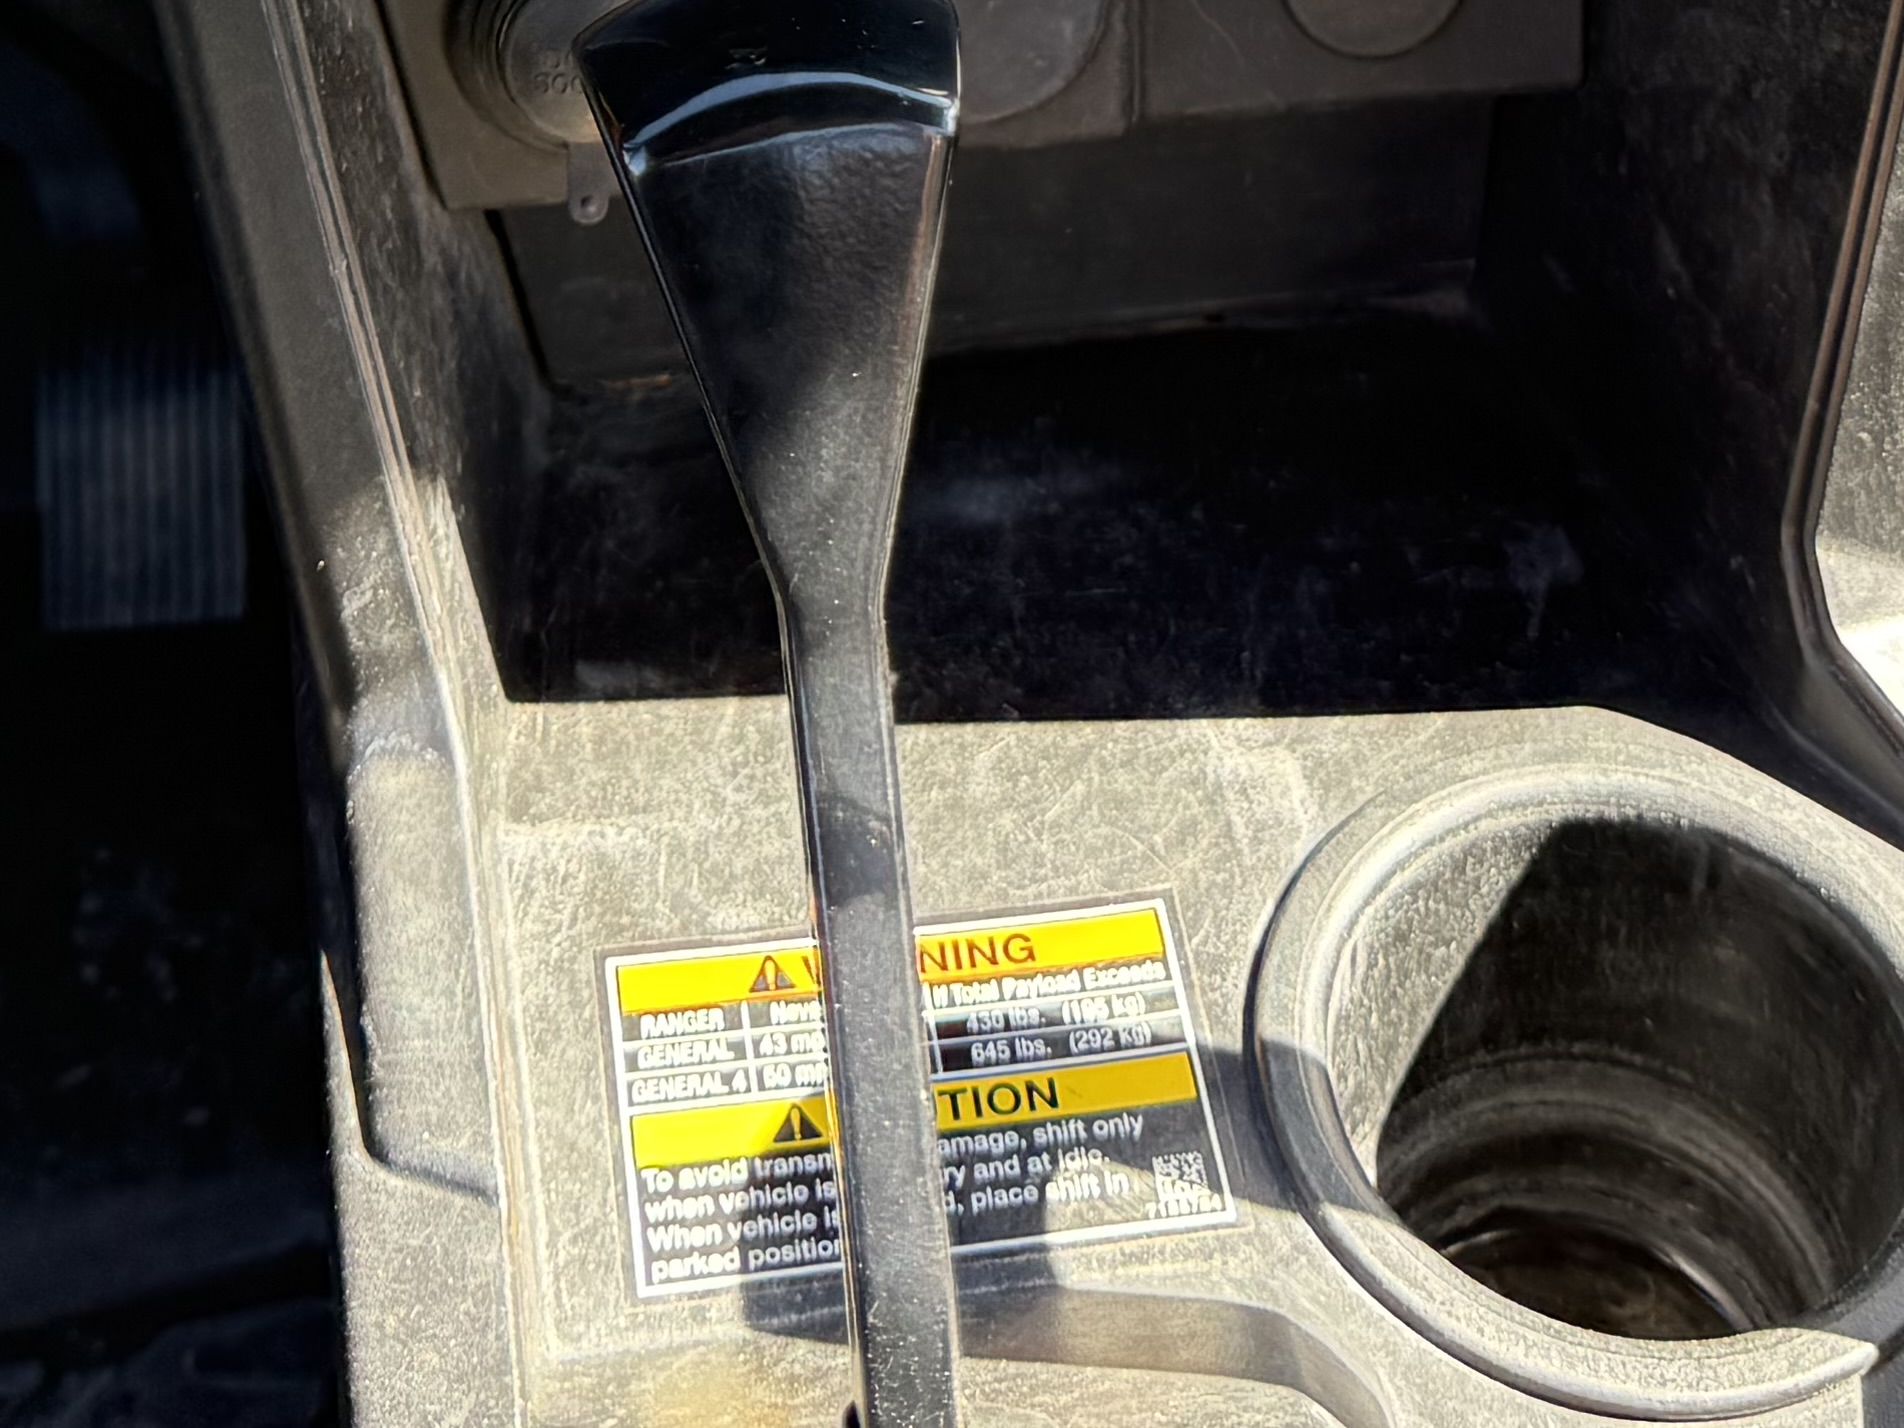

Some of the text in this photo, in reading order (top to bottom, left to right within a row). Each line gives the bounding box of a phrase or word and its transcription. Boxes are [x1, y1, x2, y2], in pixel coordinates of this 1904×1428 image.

[640, 1007, 725, 1040] RANGER
[950, 980, 999, 1006] Total
[1002, 969, 1080, 1001] Payload
[1083, 960, 1166, 989] Exceeds
[631, 1072, 729, 1104] GENERAL
[971, 1042, 1010, 1067] 645
[1015, 1037, 1052, 1060] lbs.
[1069, 1026, 1115, 1054] (292
[637, 1038, 735, 1069] GENERAL
[1010, 1006, 1045, 1028] lbs.
[938, 1077, 1059, 1121] TION
[640, 1167, 673, 1193] To
[678, 1156, 748, 1189] avoid
[938, 1129, 1027, 1157] amage,
[1033, 1119, 1087, 1147] shift
[1092, 1112, 1143, 1142] only
[645, 1194, 715, 1223] when
[719, 1181, 809, 1214] vehicle
[974, 1154, 1020, 1184] and
[1027, 1152, 1052, 1176] at
[647, 1222, 722, 1253] When
[727, 1210, 817, 1242] vehicle
[971, 1184, 1039, 1216] place
[1045, 1173, 1100, 1202] shift
[1104, 1169, 1130, 1195] in
[651, 1246, 741, 1284] parked
